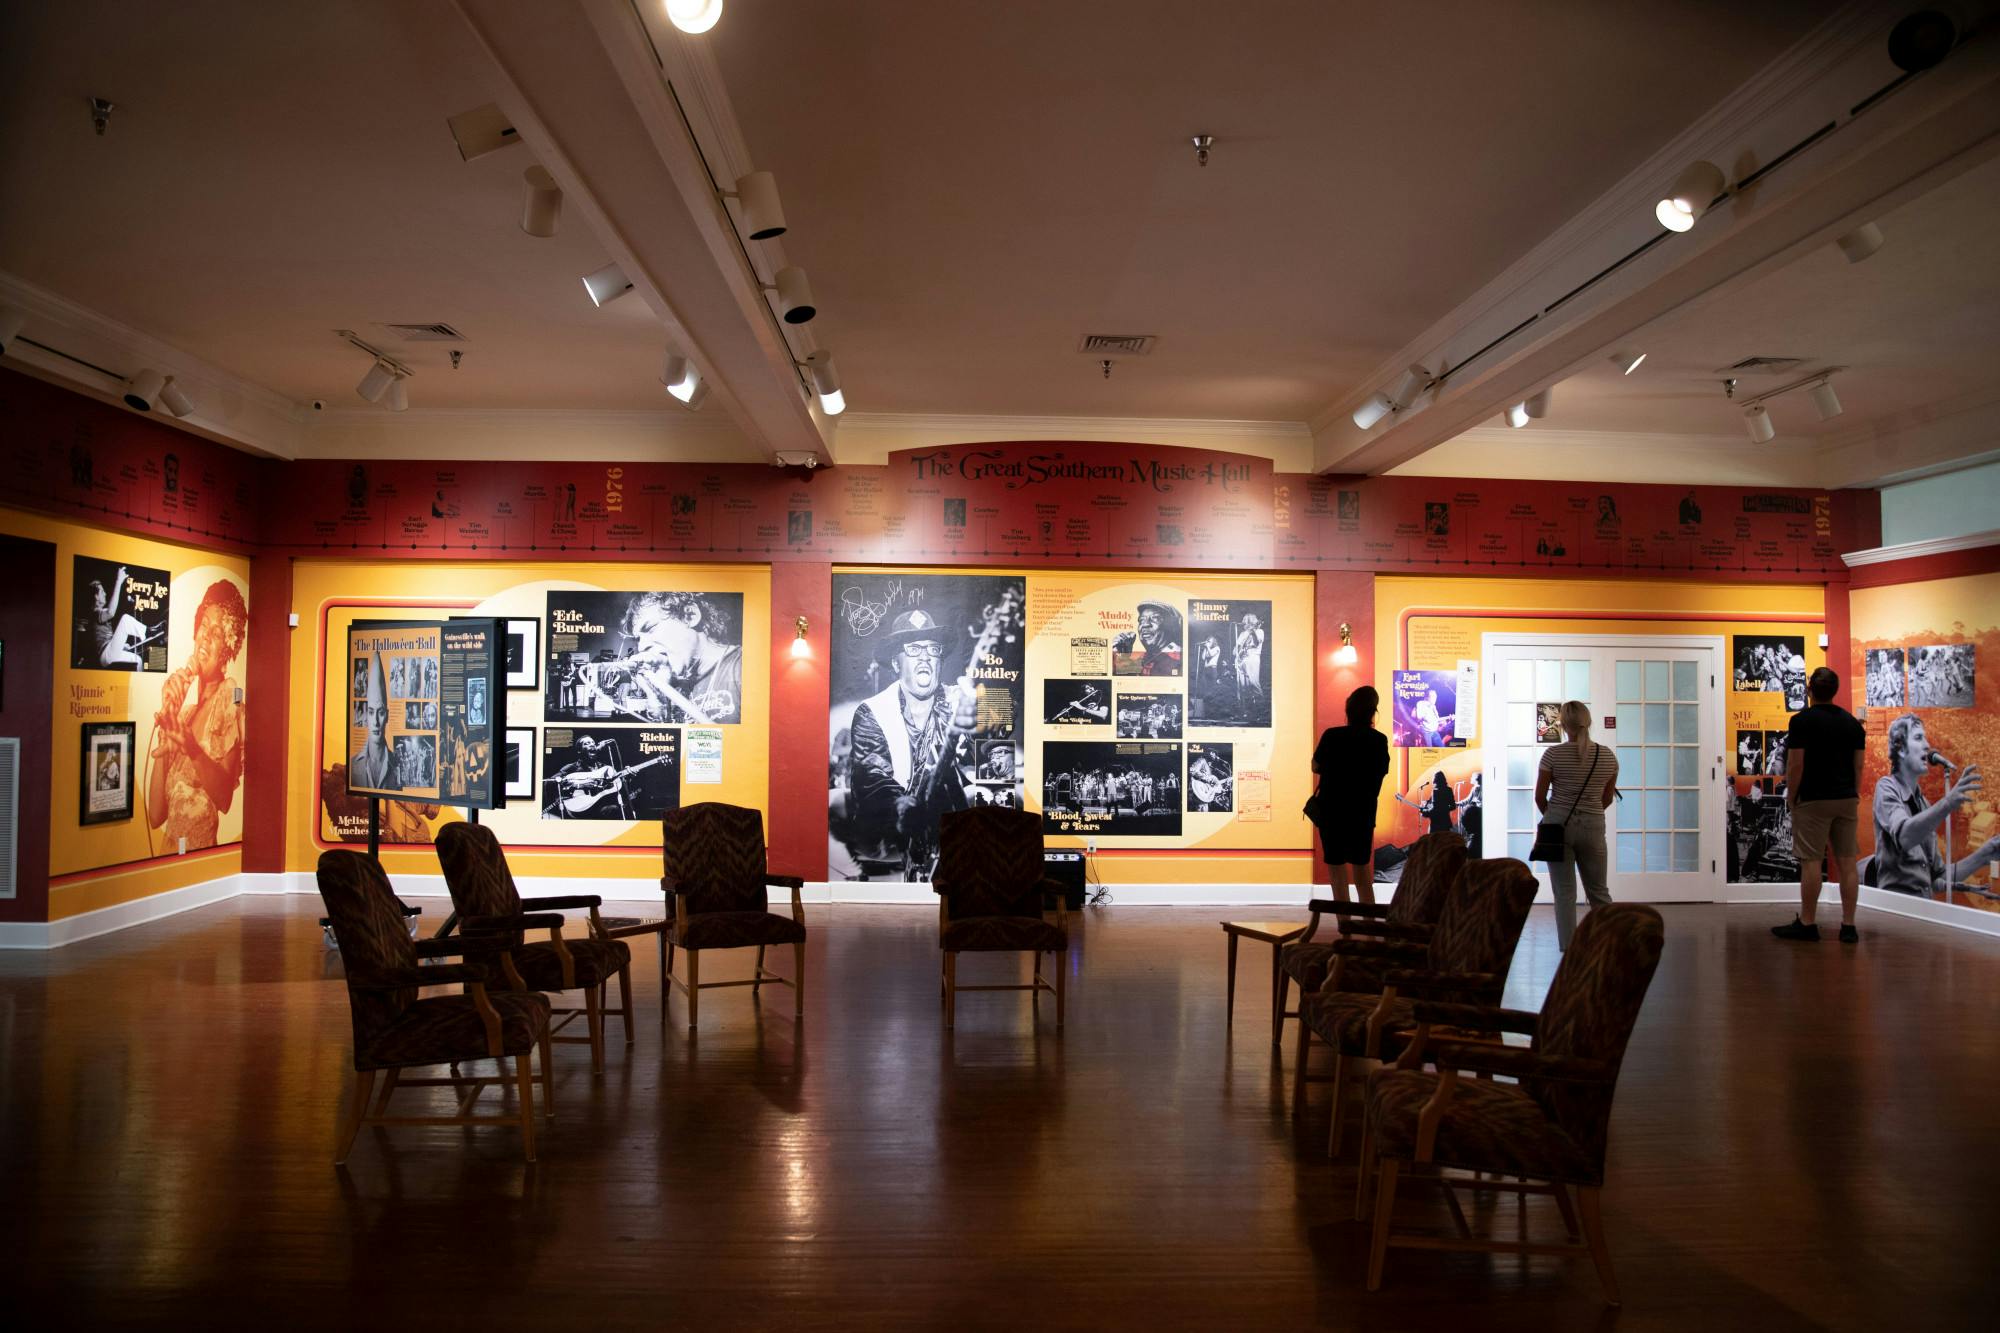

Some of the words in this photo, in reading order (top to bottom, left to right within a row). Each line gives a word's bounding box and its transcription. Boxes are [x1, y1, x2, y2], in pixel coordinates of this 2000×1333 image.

[911, 451, 953, 481] The
[959, 450, 1024, 481] Great
[1006, 452, 1123, 489] Southern
[1129, 459, 1195, 492] Music
[1199, 461, 1250, 493] Hall
[606, 466, 625, 514] 1976
[1273, 485, 1291, 529] 1975
[1815, 495, 1832, 537] 1974
[127, 577, 153, 596] Jerry
[154, 581, 169, 598] Lee
[135, 594, 159, 611] Lewis
[1193, 602, 1229, 612] Jimmy
[553, 609, 583, 622] Eric
[1098, 610, 1133, 622] Muddy
[1193, 612, 1230, 622] Buffett
[553, 622, 605, 634] Burdon
[1097, 621, 1134, 630] Waters
[355, 638, 370, 652] The
[416, 636, 436, 650] Ball
[984, 653, 1004, 666] Bo
[966, 666, 1020, 682] Diddley
[1402, 672, 1422, 683] Earl
[1394, 681, 1430, 690] Scruggs
[70, 684, 105, 700] Minnie
[1398, 689, 1426, 700] Revue
[69, 701, 112, 718] Riperton
[1735, 720, 1761, 729] Band
[640, 731, 675, 742] Richie
[640, 742, 675, 754] Havens
[338, 815, 369, 827] Meliss
[1048, 810, 1082, 823] Blood,
[1084, 810, 1113, 822] Sweat
[328, 826, 385, 837] Manchesr
[1060, 821, 1070, 830] &
[1072, 821, 1101, 831] Tears
